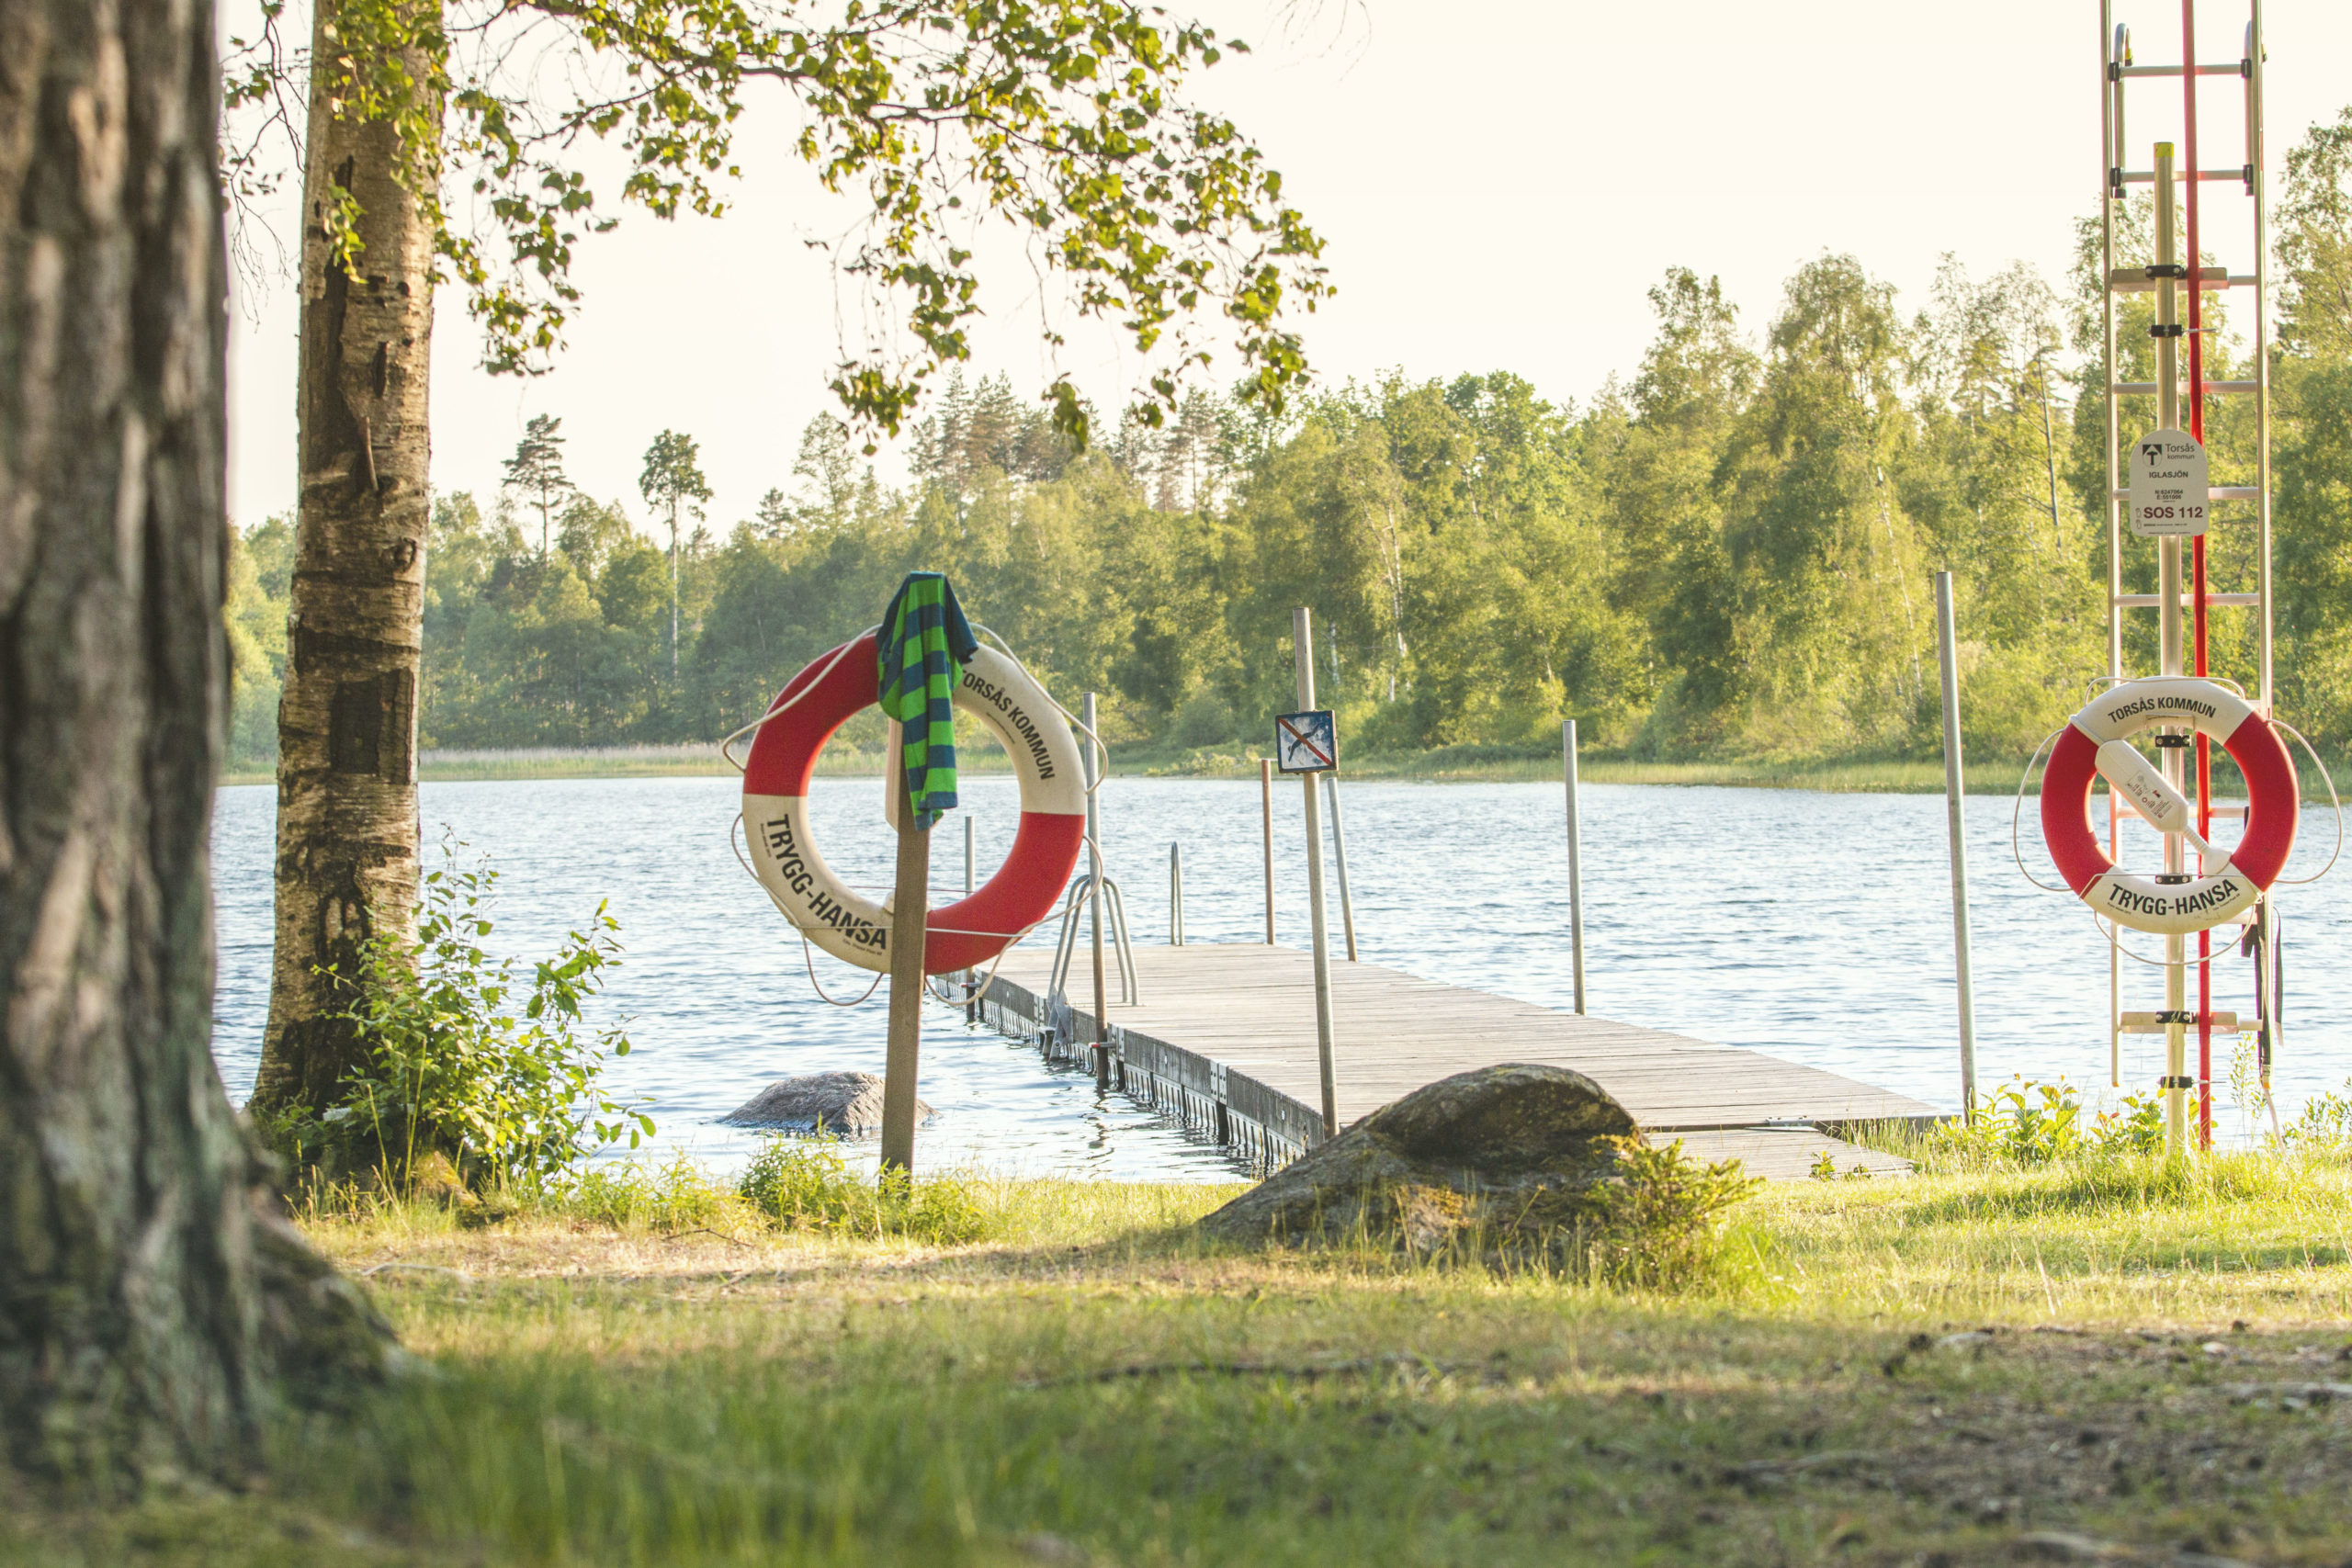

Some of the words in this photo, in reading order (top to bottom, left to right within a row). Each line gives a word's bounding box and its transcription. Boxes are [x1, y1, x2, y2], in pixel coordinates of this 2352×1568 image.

[2165, 443, 2195, 452] Torsås
[2149, 469, 2188, 479] IGLASJÖN
[2143, 506, 2175, 519] SOS
[2178, 506, 2203, 519] 112
[2108, 696, 2155, 724] TORSÅS
[2157, 696, 2216, 718] KOMMUN
[962, 670, 1012, 712] ORSÅS
[1008, 705, 1056, 781] KOMMUN
[767, 813, 887, 950] TRYGG-HANSA
[2109, 878, 2239, 916] TRYGG-HANSA
